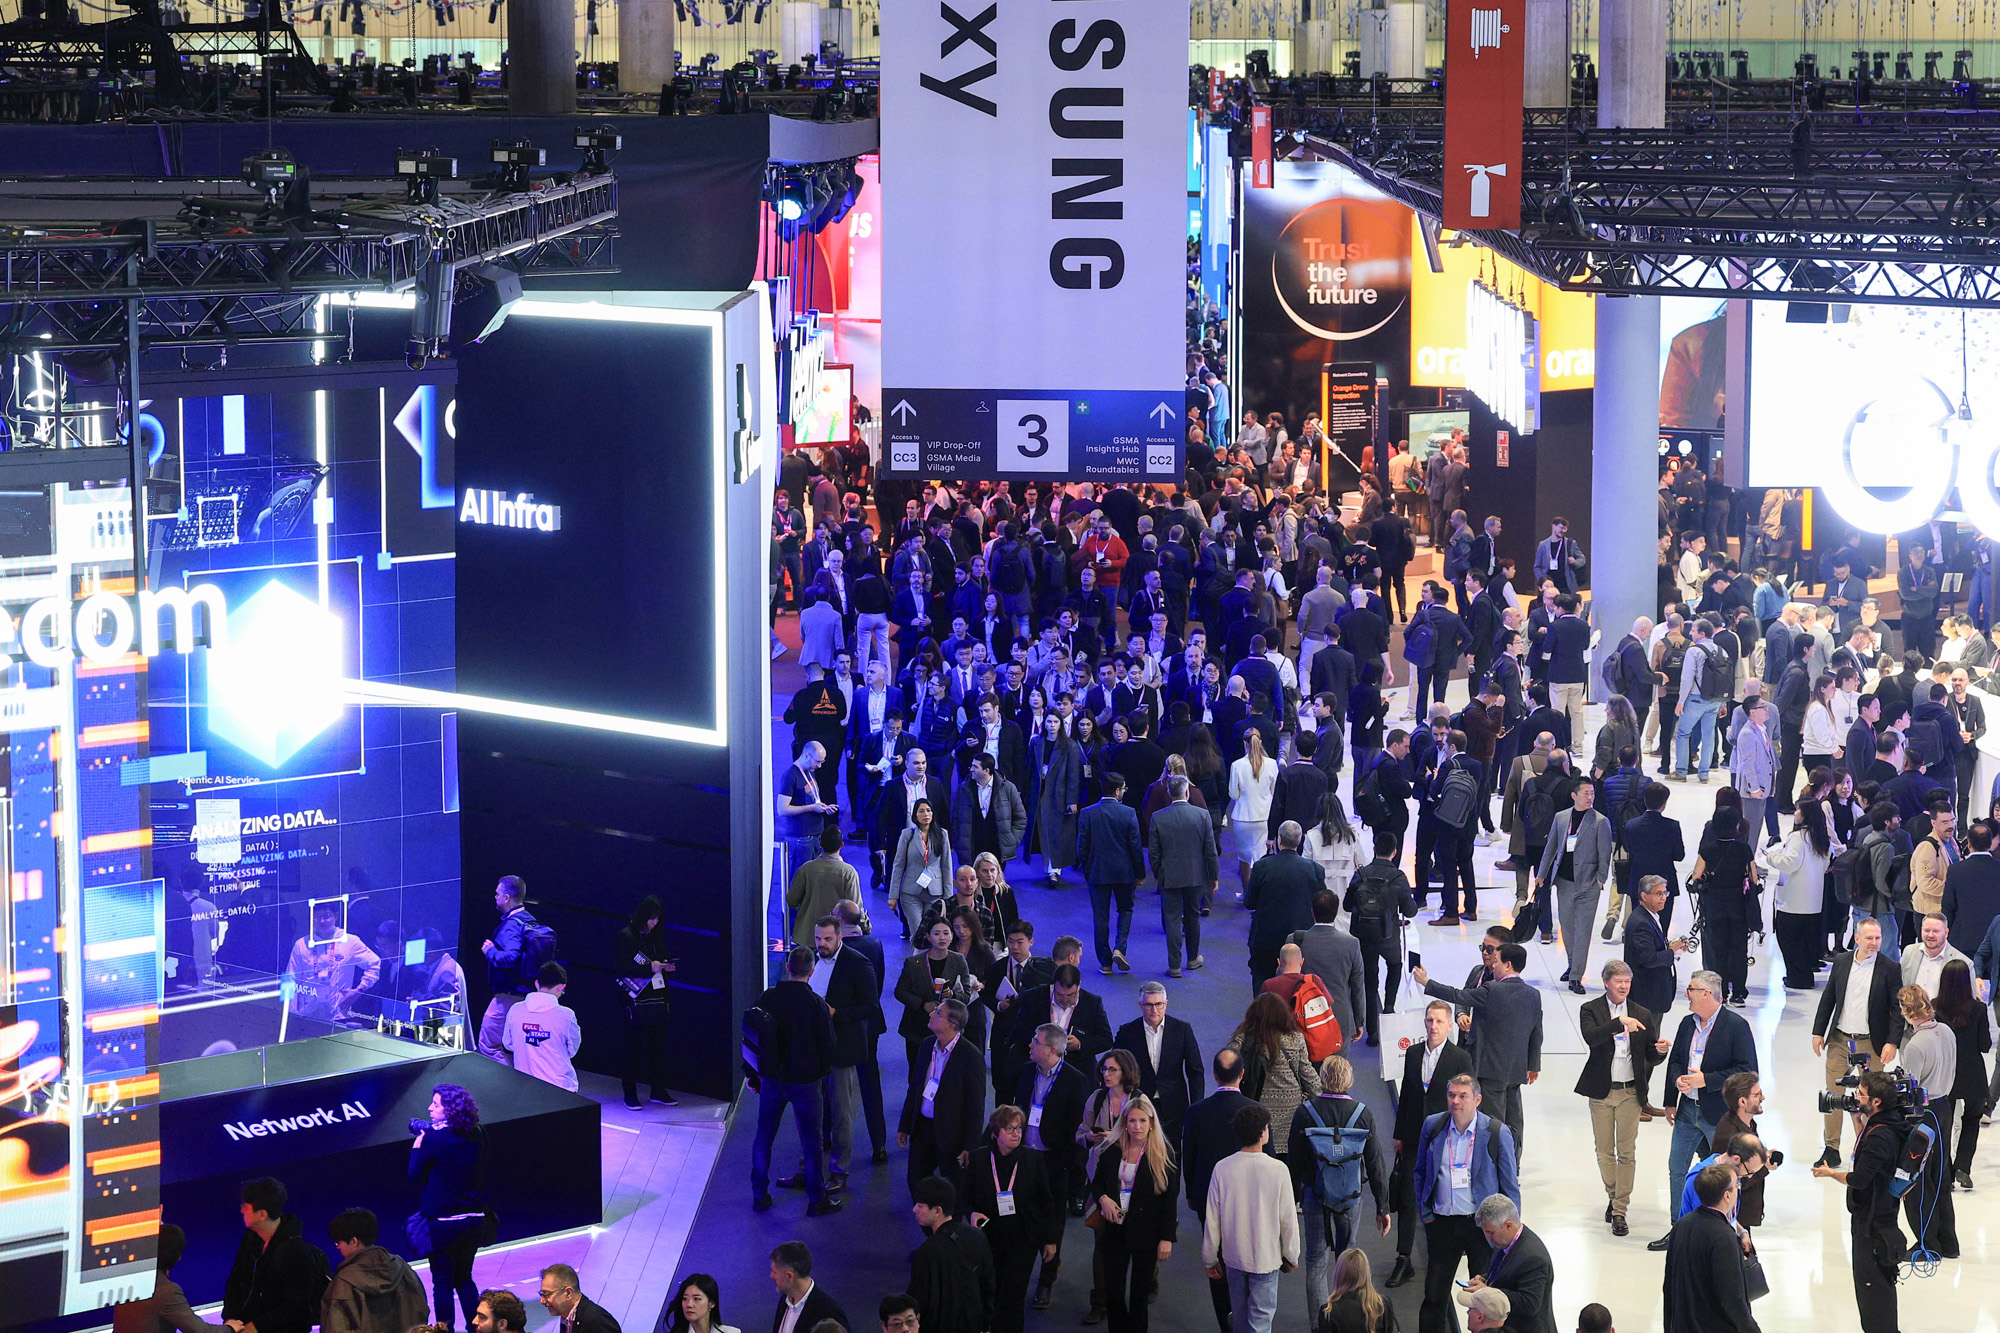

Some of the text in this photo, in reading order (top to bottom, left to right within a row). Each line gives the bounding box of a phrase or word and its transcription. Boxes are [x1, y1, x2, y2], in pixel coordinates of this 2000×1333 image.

[1048, 0, 1126, 289] SUNG
[1303, 237, 1372, 260] Trust
[1307, 262, 1348, 282] the
[1307, 284, 1378, 305] future
[1333, 385, 1352, 393] Orange
[1333, 392, 1360, 400] Inspection
[1016, 414, 1049, 458] 3
[1113, 437, 1140, 445] GSMA
[927, 441, 981, 451] VIP Drop-Off
[1085, 445, 1140, 454] Insights Hub
[893, 452, 917, 463] CC3
[927, 454, 981, 462] GSMA Media
[1116, 457, 1140, 465] MWC
[1149, 455, 1172, 465] CC2
[927, 463, 956, 473] Village
[1085, 465, 1140, 474] Roundtables
[460, 488, 556, 531] AI Infra
[177, 775, 260, 786] Agentic AI Service
[189, 815, 282, 842] ANALYZING
[284, 809, 338, 829] DATA...
[209, 883, 238, 895] RETURN
[191, 903, 257, 922] ANALYZE_DATA()
[223, 1101, 371, 1141] Network AI
